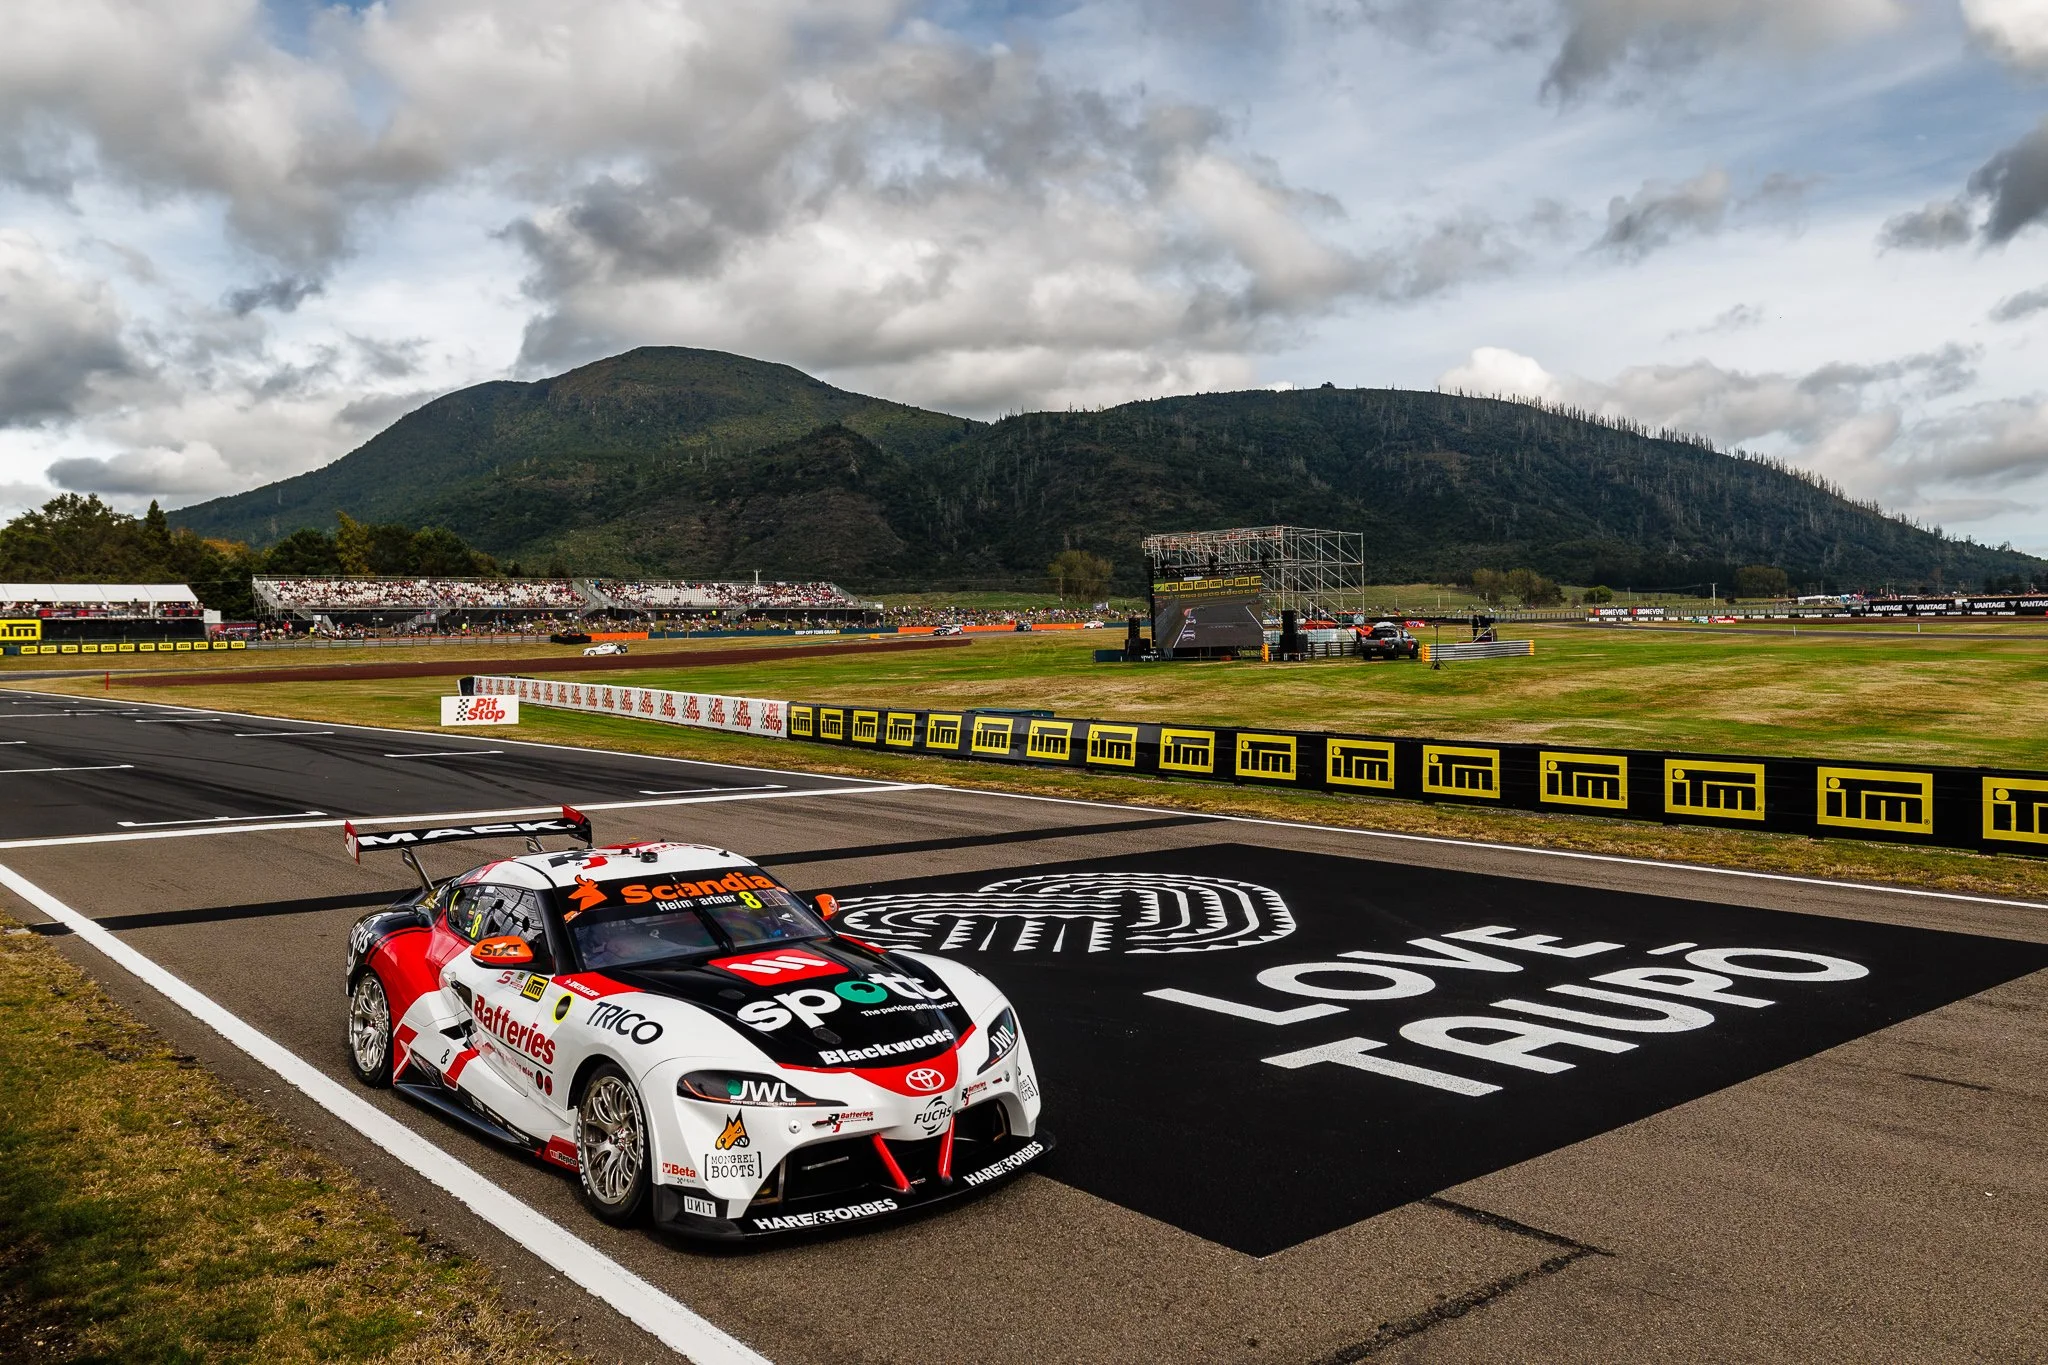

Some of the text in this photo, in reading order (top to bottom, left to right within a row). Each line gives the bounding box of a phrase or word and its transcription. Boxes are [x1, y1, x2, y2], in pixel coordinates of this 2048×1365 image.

[1872, 604, 1903, 612] VANTAGE
[1916, 603, 1947, 611] VANTAGE
[1973, 601, 2006, 610] VANTAGE
[559, 692, 567, 704] Stop
[572, 693, 581, 706] Stop
[587, 695, 597, 708] Stop
[604, 698, 614, 710] Stop
[643, 691, 651, 703] Pit
[688, 696, 697, 709] Pit
[714, 698, 722, 710] Pit
[476, 698, 498, 713] Pit
[622, 700, 632, 712] Stop
[641, 703, 653, 715] Stop
[663, 705, 675, 719] Stop
[738, 701, 748, 715] Pit
[769, 703, 778, 718] Pit
[467, 708, 505, 723] Stop
[686, 708, 700, 722] Stop
[712, 710, 725, 724] Stop
[736, 714, 751, 730] Stop
[766, 717, 782, 733] Stop
[358, 820, 567, 846] MACK
[621, 871, 776, 904] Scandia
[656, 890, 763, 913] Heimartner 8
[470, 913, 483, 938] 8
[1143, 924, 1625, 1026] LOVE
[568, 980, 600, 997] DUNLOP
[736, 972, 948, 1032] spott
[861, 1001, 959, 1017] The parking difference
[474, 993, 556, 1065] Batteries
[586, 1001, 664, 1045] TRICO
[818, 1028, 954, 1066] Blackwoods
[990, 1025, 1015, 1056] JWL
[730, 1080, 797, 1102] JWL
[968, 1081, 987, 1093] Batteries
[840, 1110, 874, 1119] Batteries
[913, 1105, 953, 1125] FUCHS
[558, 1152, 577, 1166] Repco
[711, 1154, 755, 1165] MONGREL
[963, 1140, 1044, 1186] HARE&FORBES
[672, 1164, 696, 1178] Beta
[711, 1165, 755, 1179] BOOTS
[752, 1198, 898, 1230] HARE&FORBES
